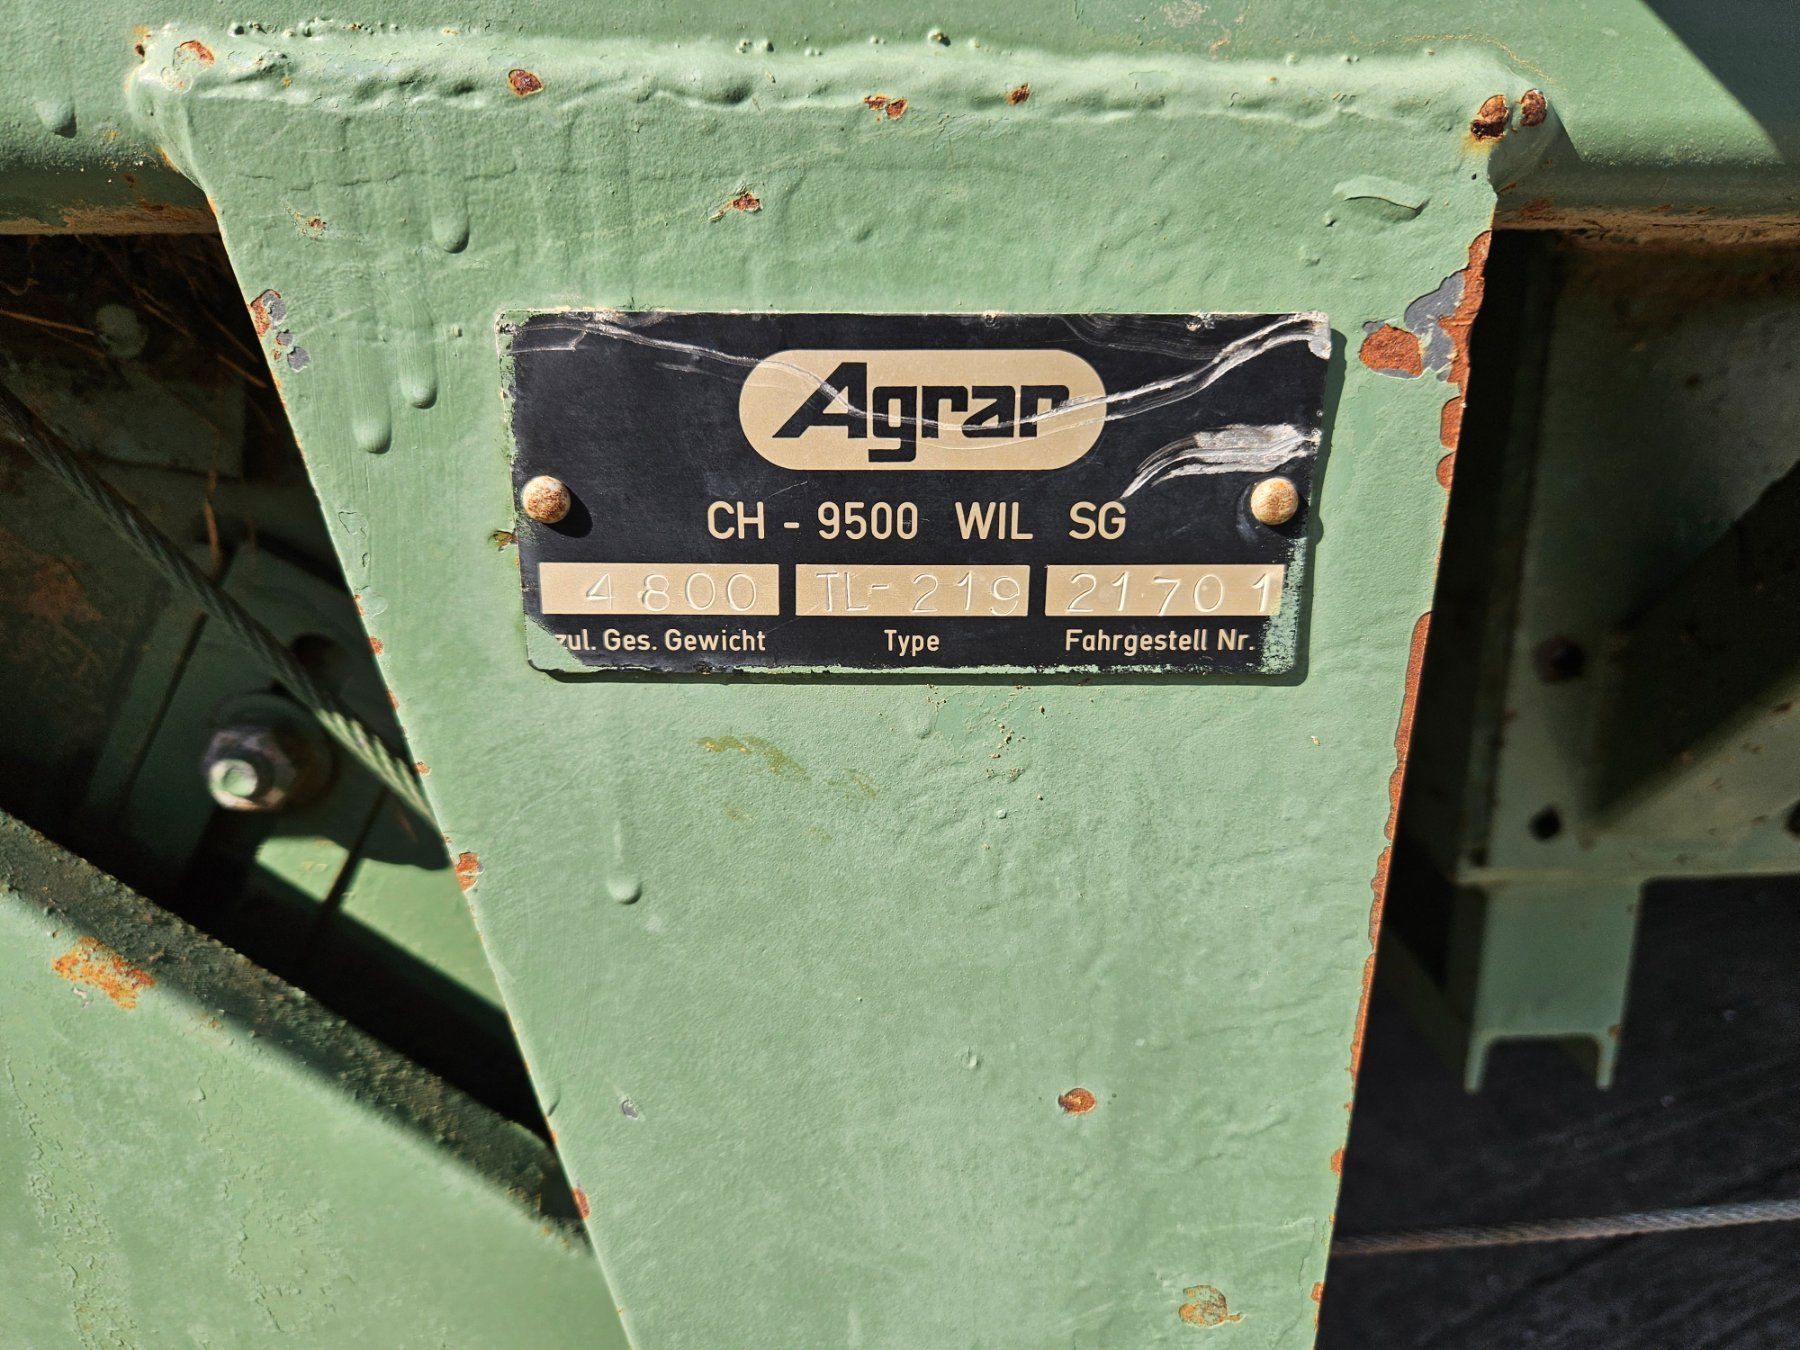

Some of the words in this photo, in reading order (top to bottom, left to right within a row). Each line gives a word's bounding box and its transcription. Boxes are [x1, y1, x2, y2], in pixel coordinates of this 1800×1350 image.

[771, 361, 1070, 463] Agrar
[707, 501, 765, 539] CH
[783, 521, 800, 529] -
[817, 501, 918, 540] 9500
[955, 502, 1034, 539] WIL
[1068, 501, 1126, 540] SG
[585, 572, 757, 611] 4800
[1066, 572, 1275, 616] 21701
[603, 629, 656, 651] Ges.
[665, 628, 766, 651] Gewicht
[884, 629, 941, 655] Type
[1065, 628, 1208, 656] Fahrgestell
[1217, 629, 1256, 651] Nr.
